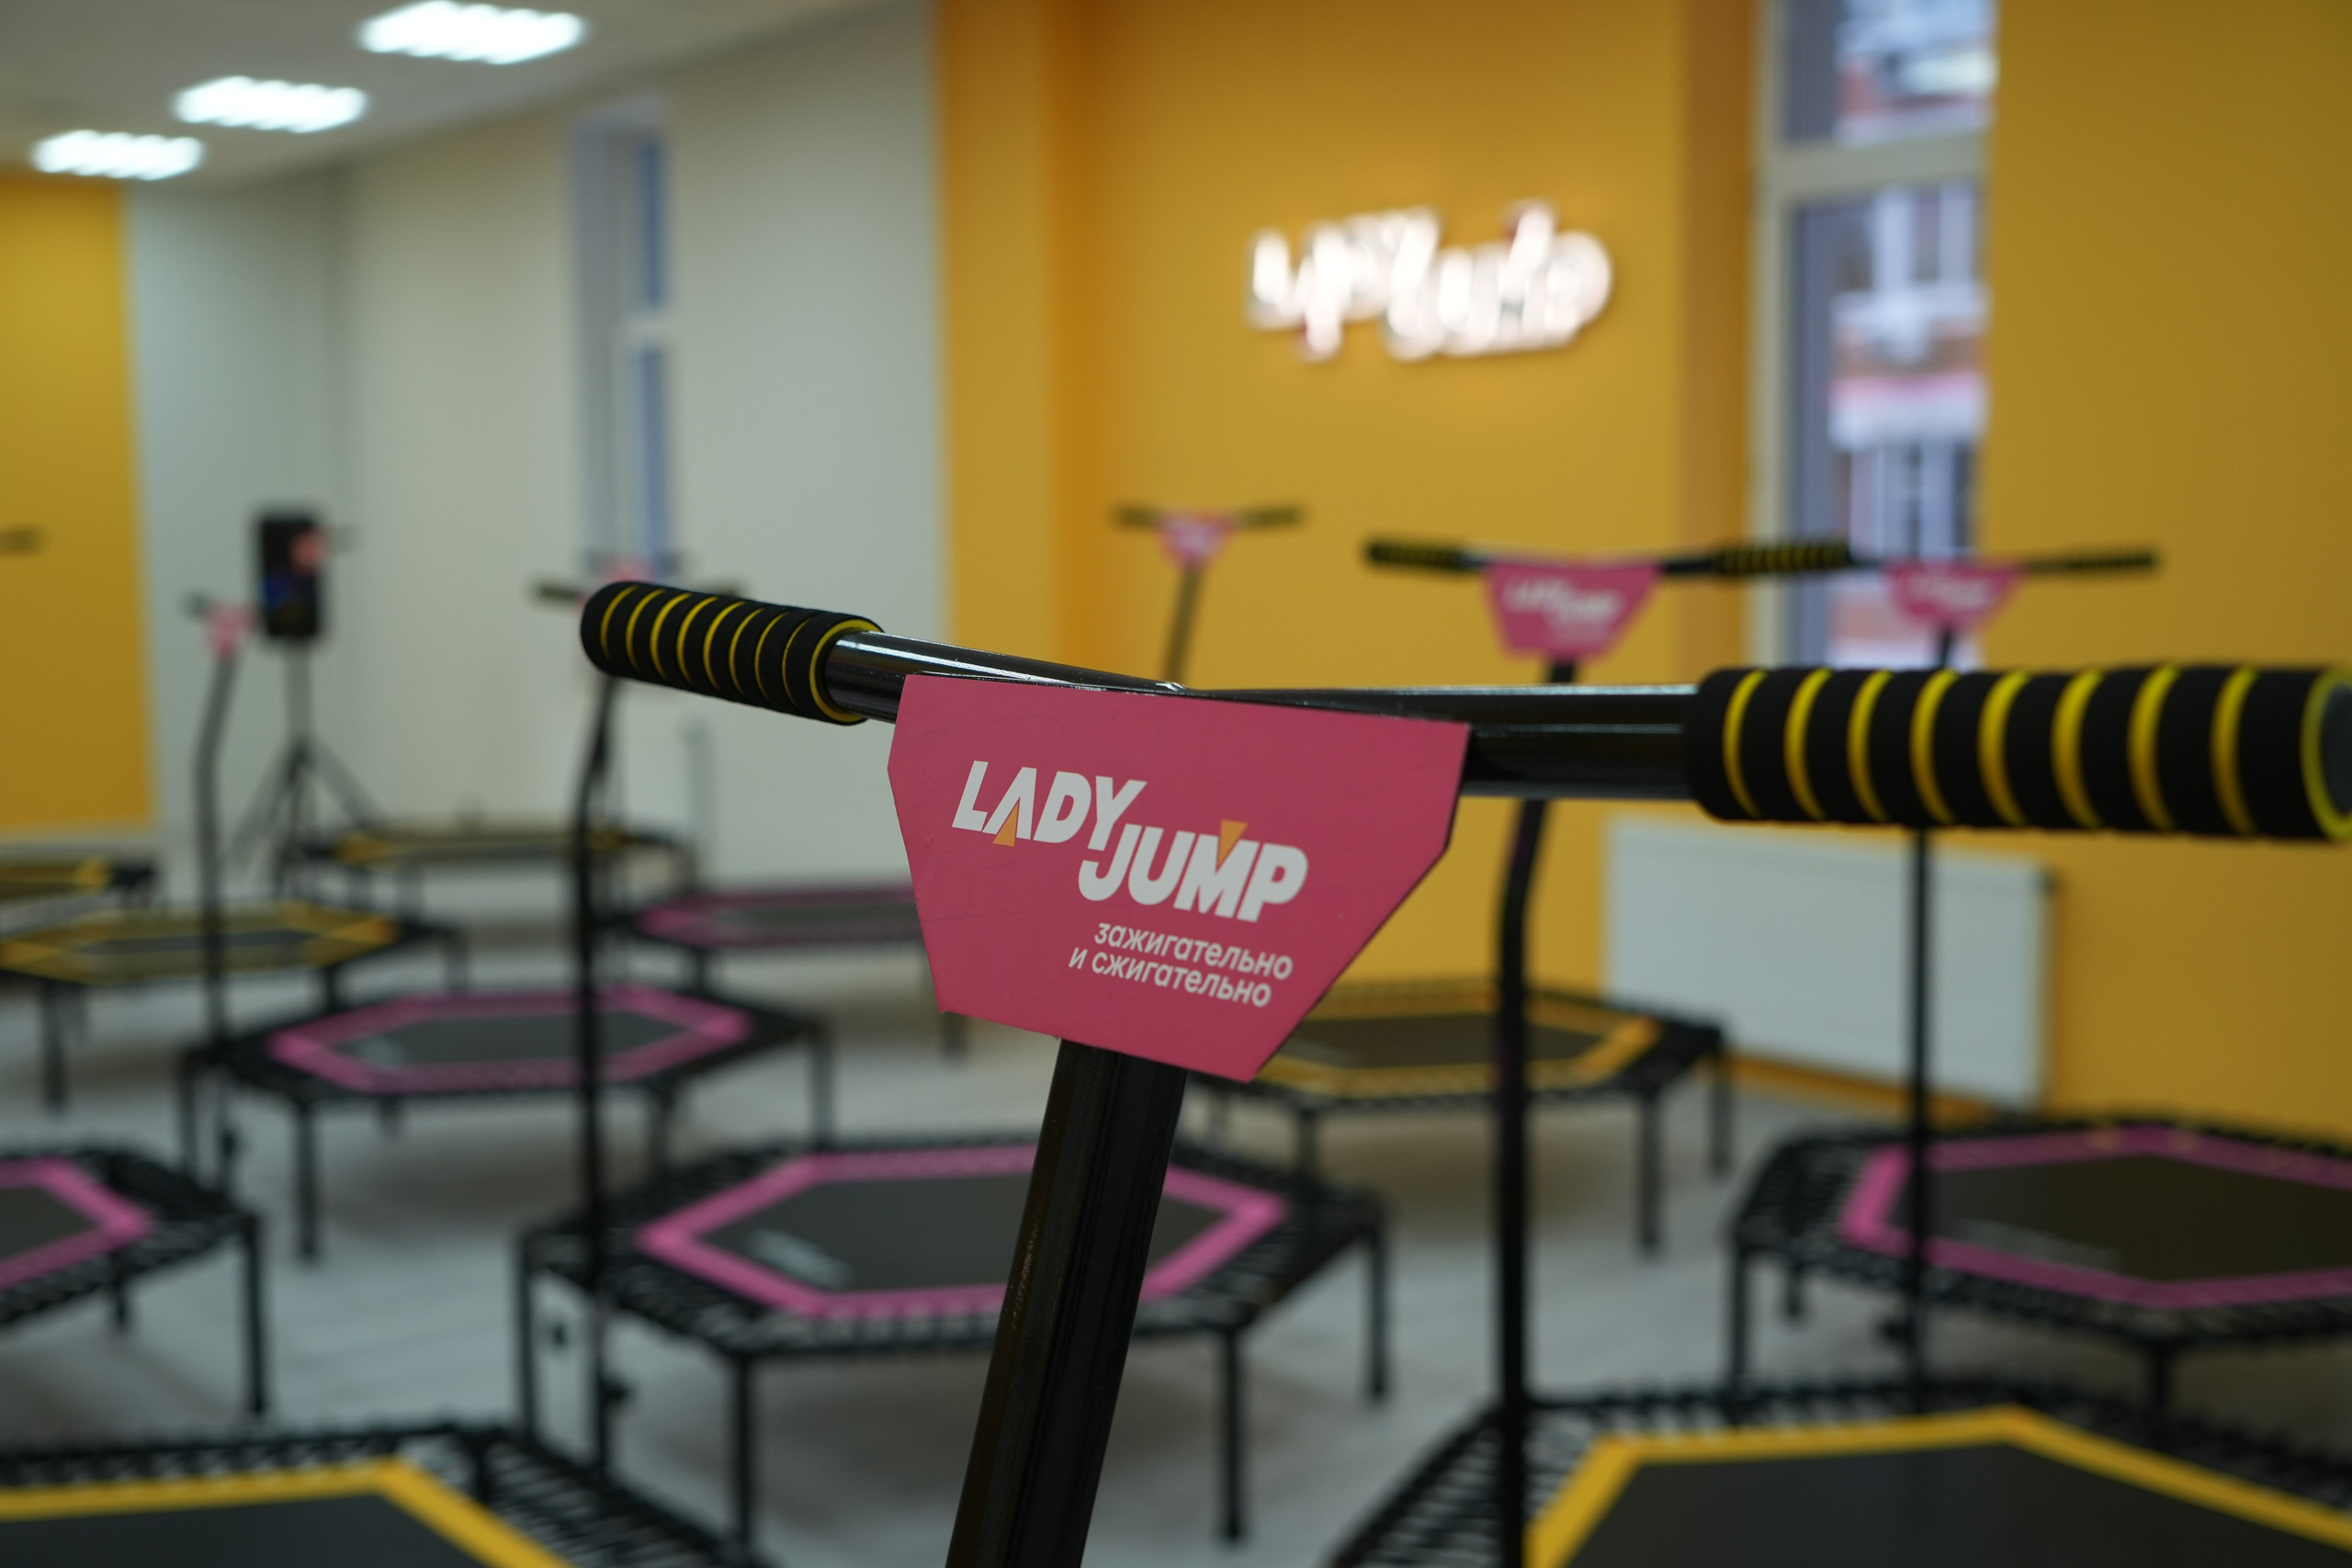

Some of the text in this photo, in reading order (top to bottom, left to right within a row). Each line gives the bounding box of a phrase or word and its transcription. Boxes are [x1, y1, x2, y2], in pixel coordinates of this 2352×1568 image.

[951, 760, 1148, 852] LADY
[1078, 822, 1308, 922] JUMP
[1068, 947, 1272, 1009] и сжигательно
[1093, 921, 1294, 981] зажигательно
